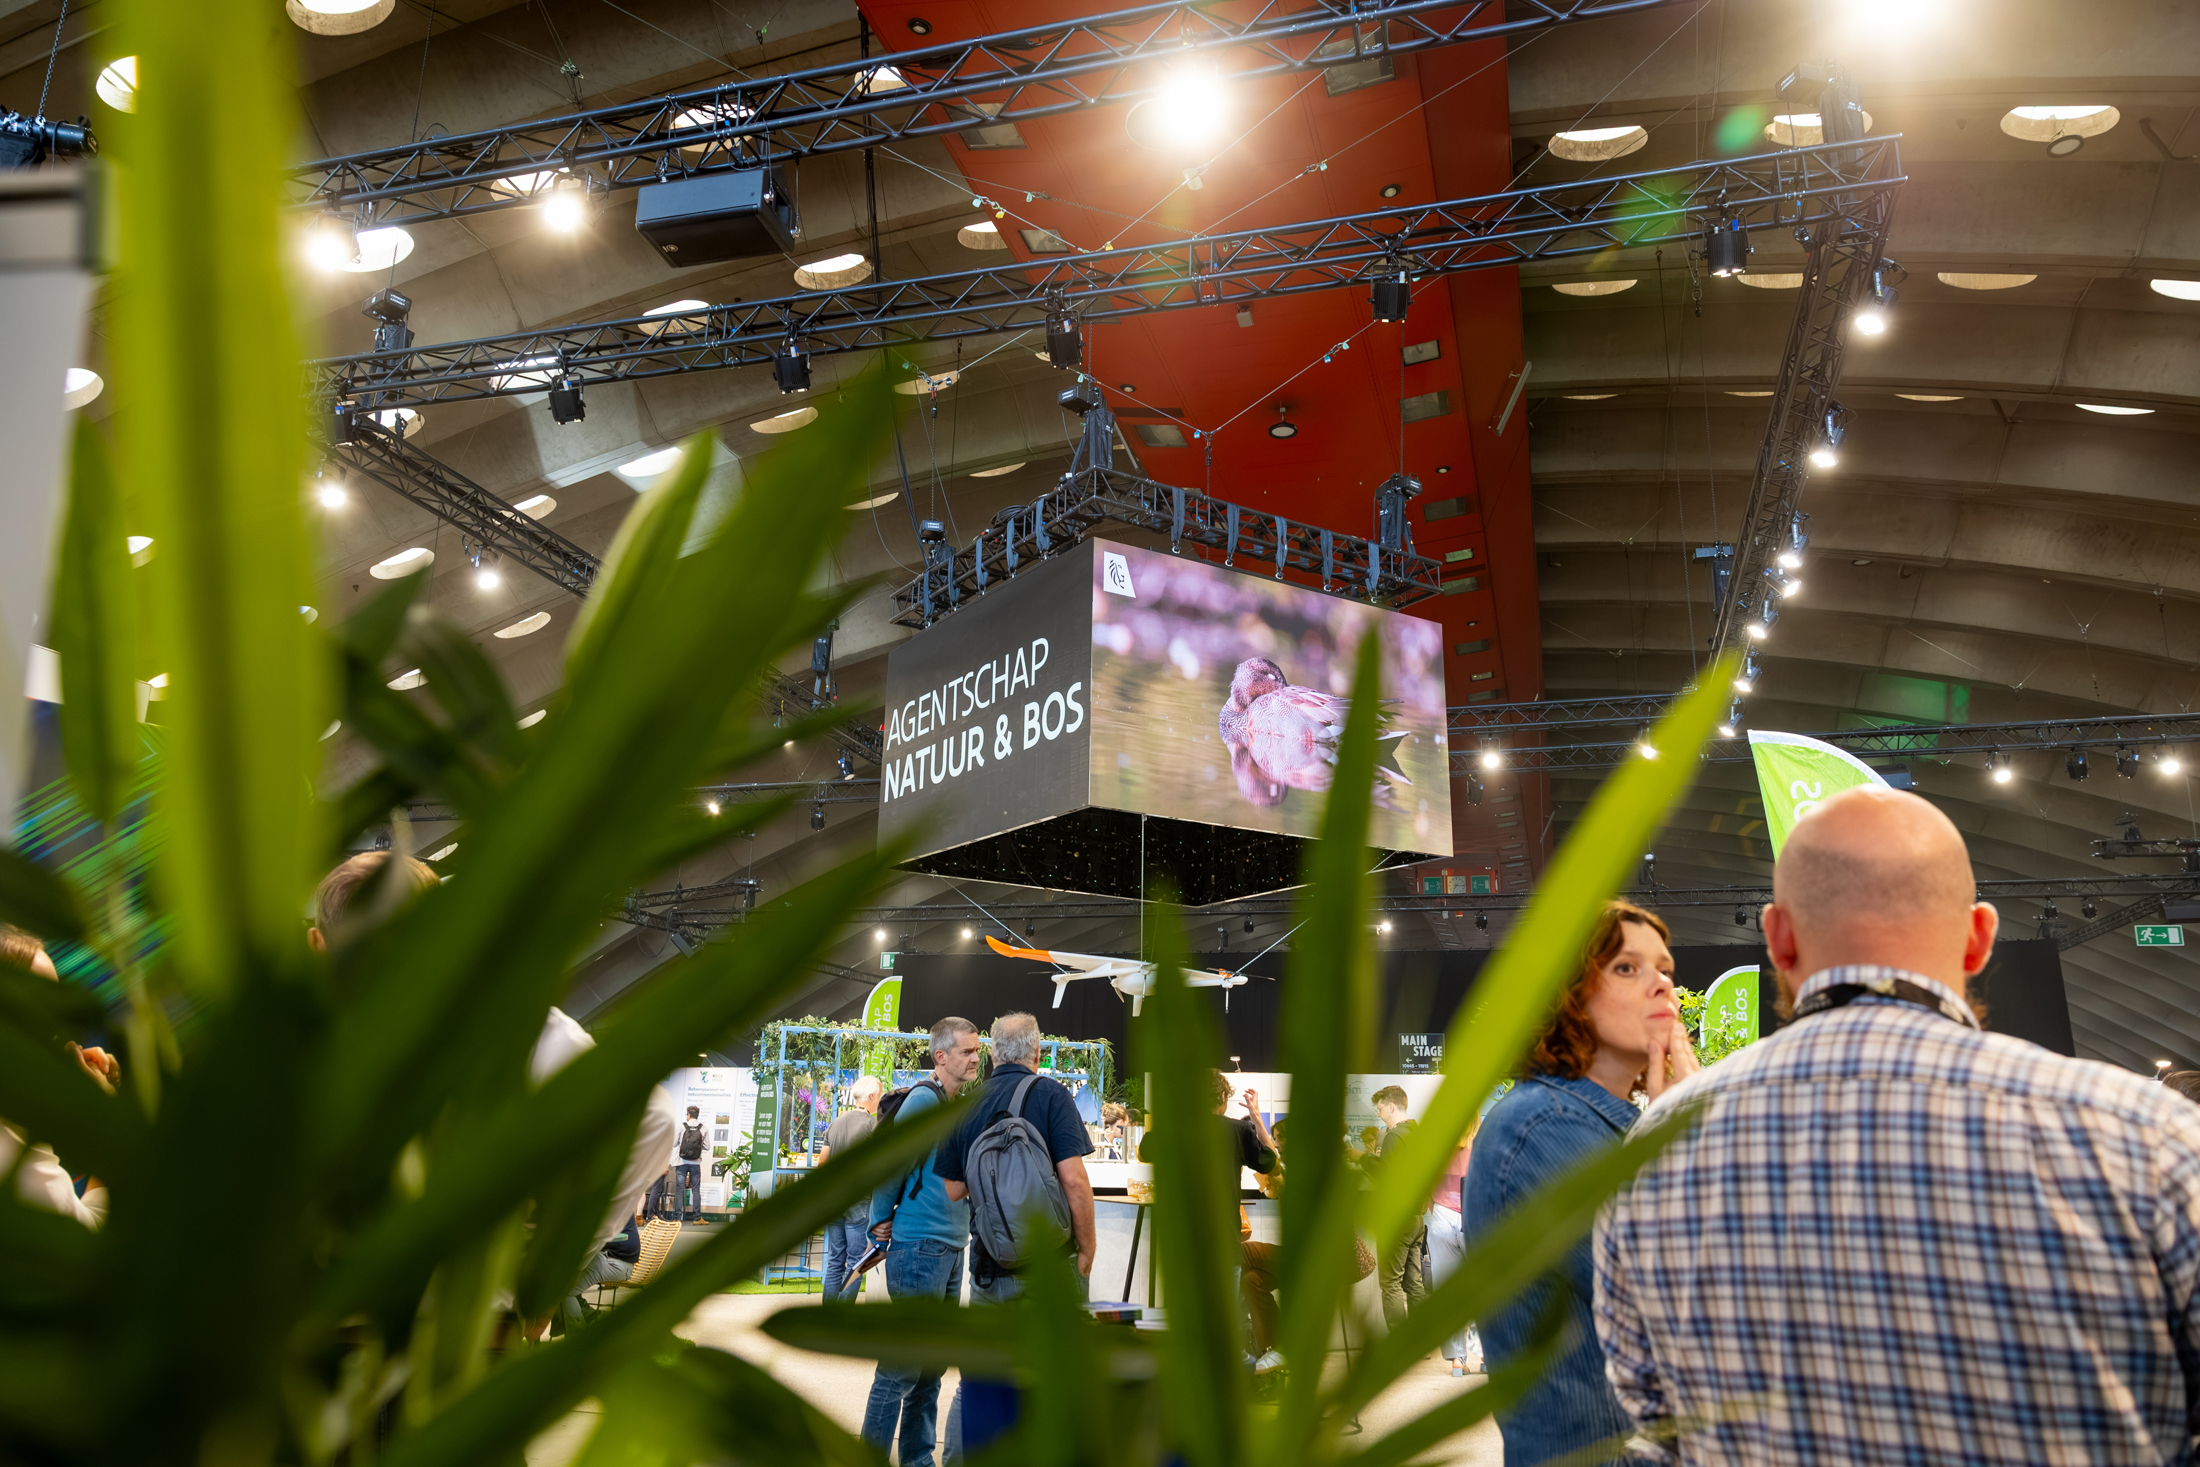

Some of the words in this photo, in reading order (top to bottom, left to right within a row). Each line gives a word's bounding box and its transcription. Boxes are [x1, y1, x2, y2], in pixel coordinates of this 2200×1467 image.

[886, 637, 1049, 751] AGENTSCHAP
[884, 725, 985, 803] NATUUR
[994, 713, 1013, 760] &
[1023, 681, 1084, 750] BOS
[882, 993, 893, 1022] BOS
[1735, 987, 1748, 1021] BOS
[1401, 1035, 1428, 1046] MAIN
[1413, 1046, 1443, 1057] STAGE
